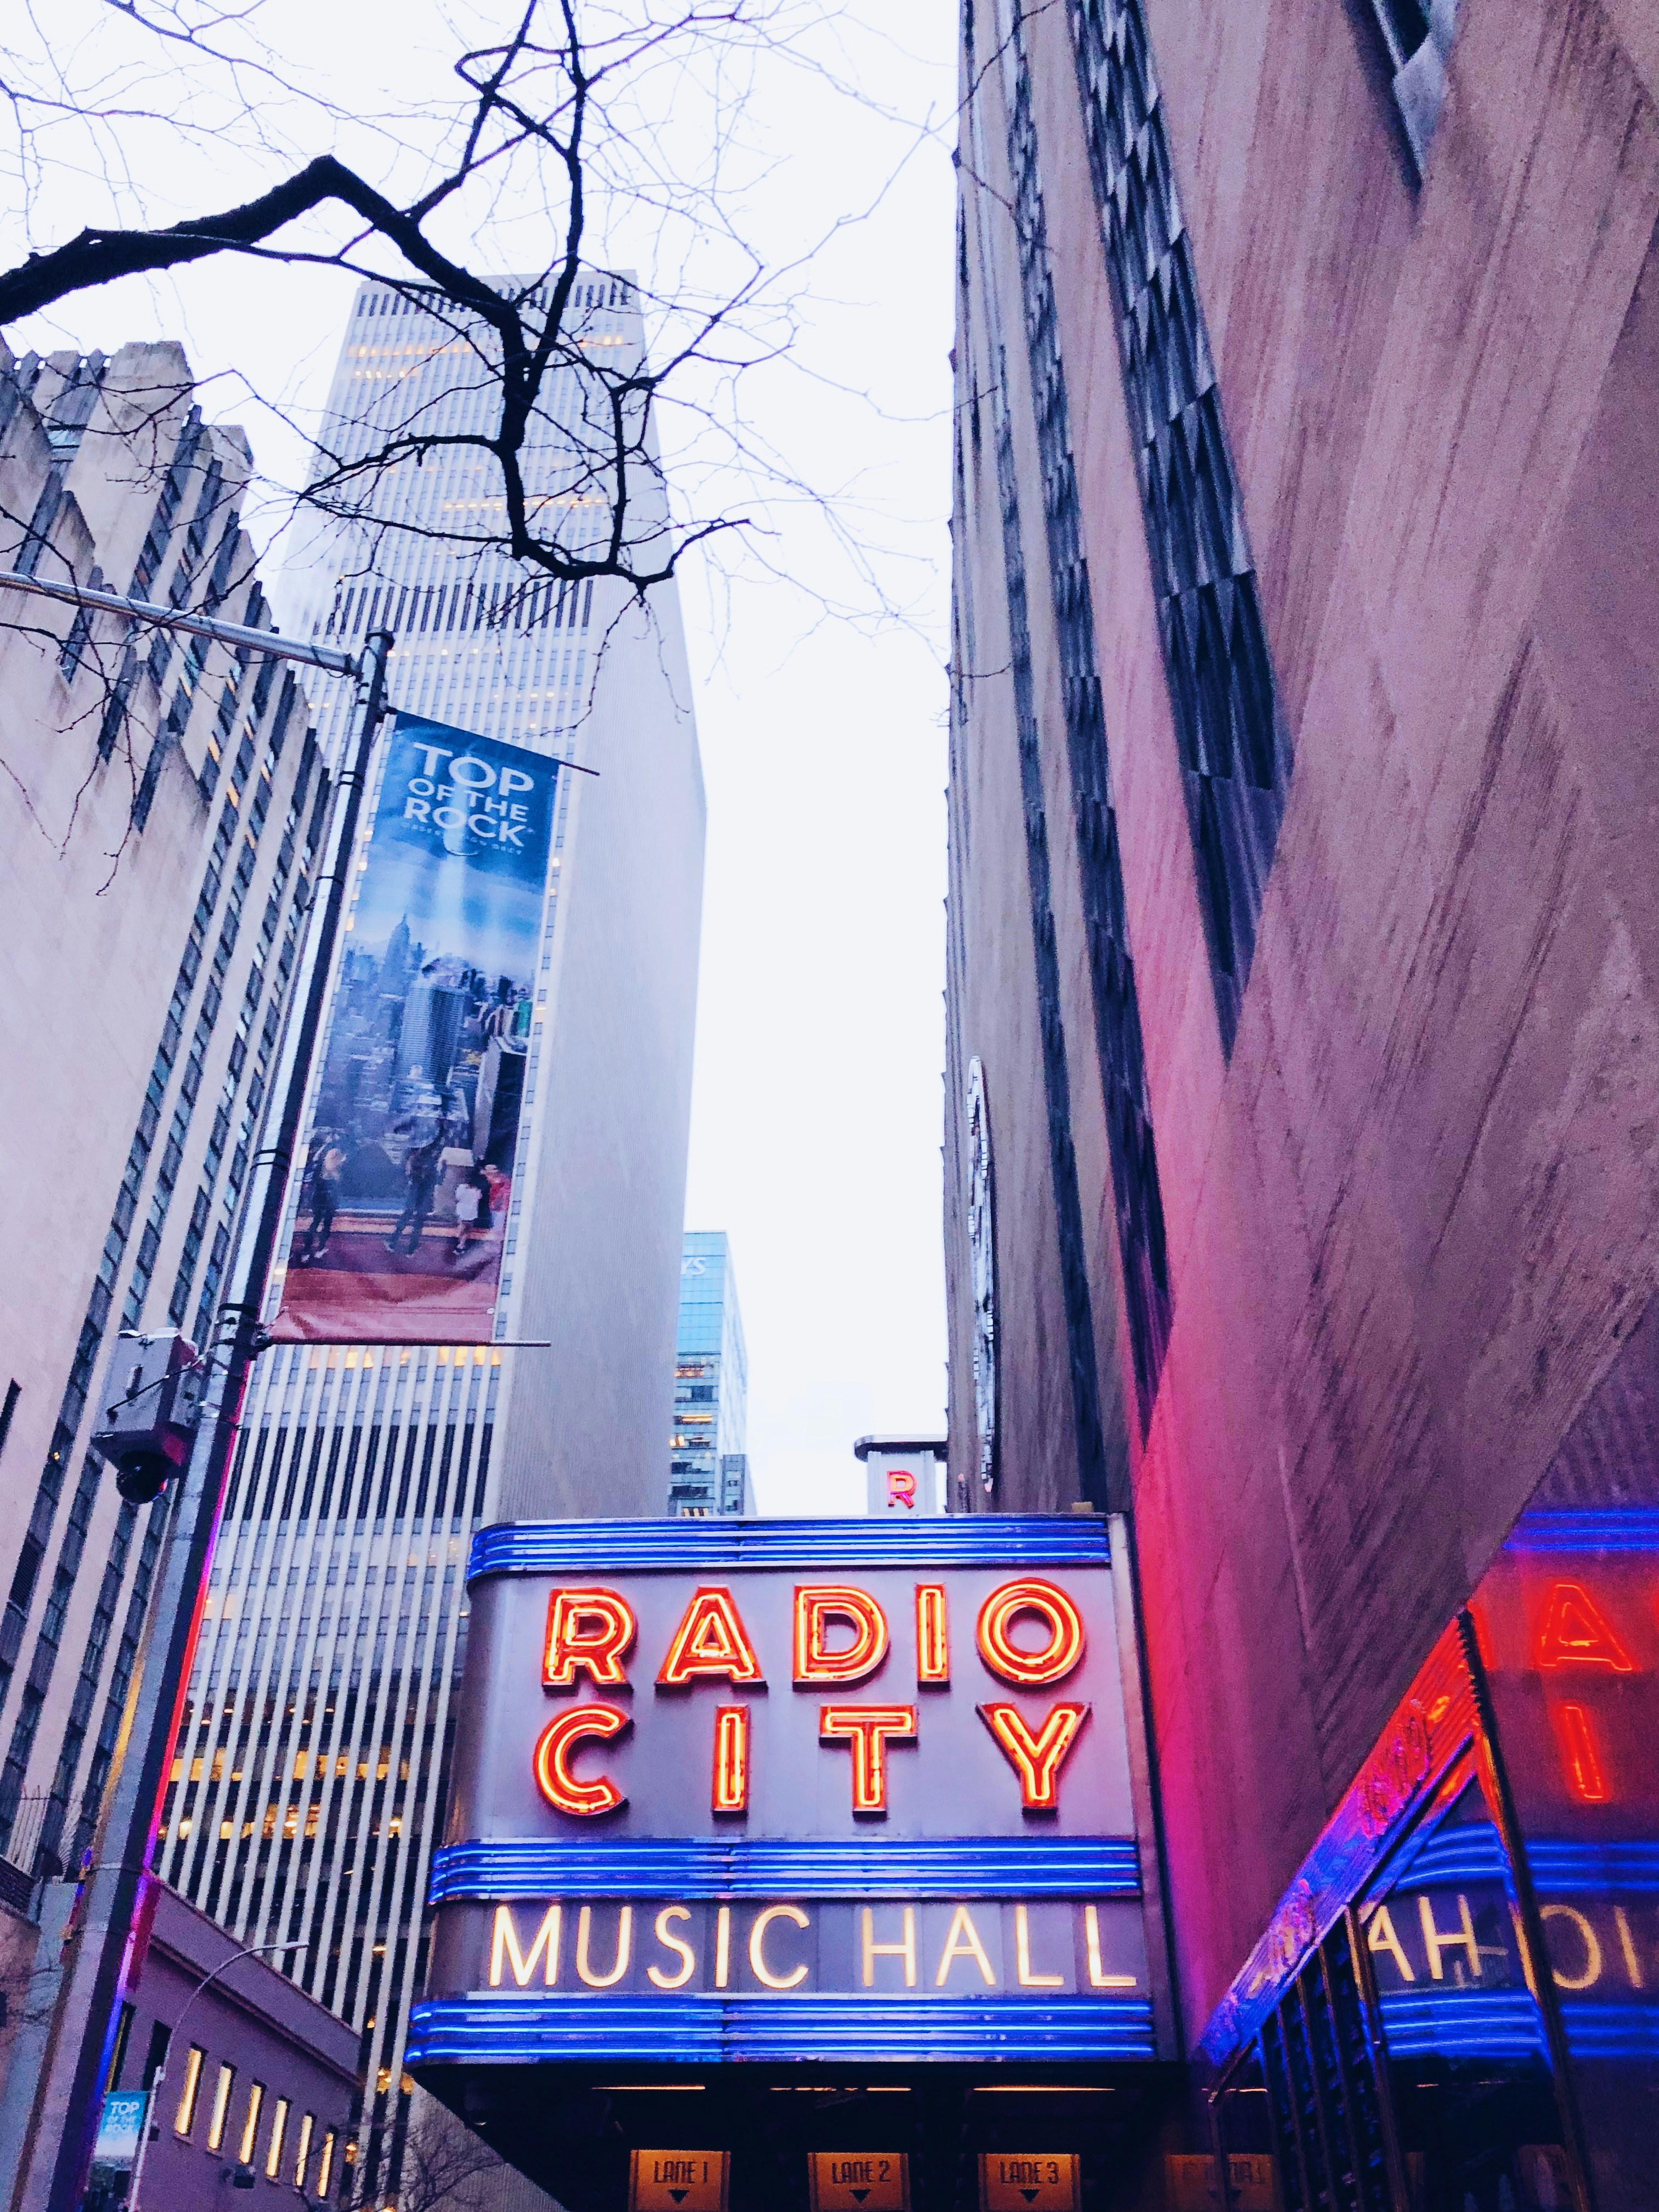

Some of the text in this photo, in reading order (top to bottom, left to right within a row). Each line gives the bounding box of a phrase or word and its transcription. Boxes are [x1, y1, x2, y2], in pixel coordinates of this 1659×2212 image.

[413, 742, 534, 797] TOP
[403, 797, 527, 847] ROCK
[408, 778, 529, 822] OF THE
[887, 1470, 918, 1509] R
[541, 1577, 1087, 1691] RADIO
[534, 1702, 1091, 1819] CITY
[488, 1905, 1137, 1989] MUSIC HALL
[110, 2101, 140, 2115] TOP
[653, 2160, 709, 2184] LANE 1
[831, 2160, 891, 2185] LANE 2
[1000, 2161, 1060, 2184] LANE 3
